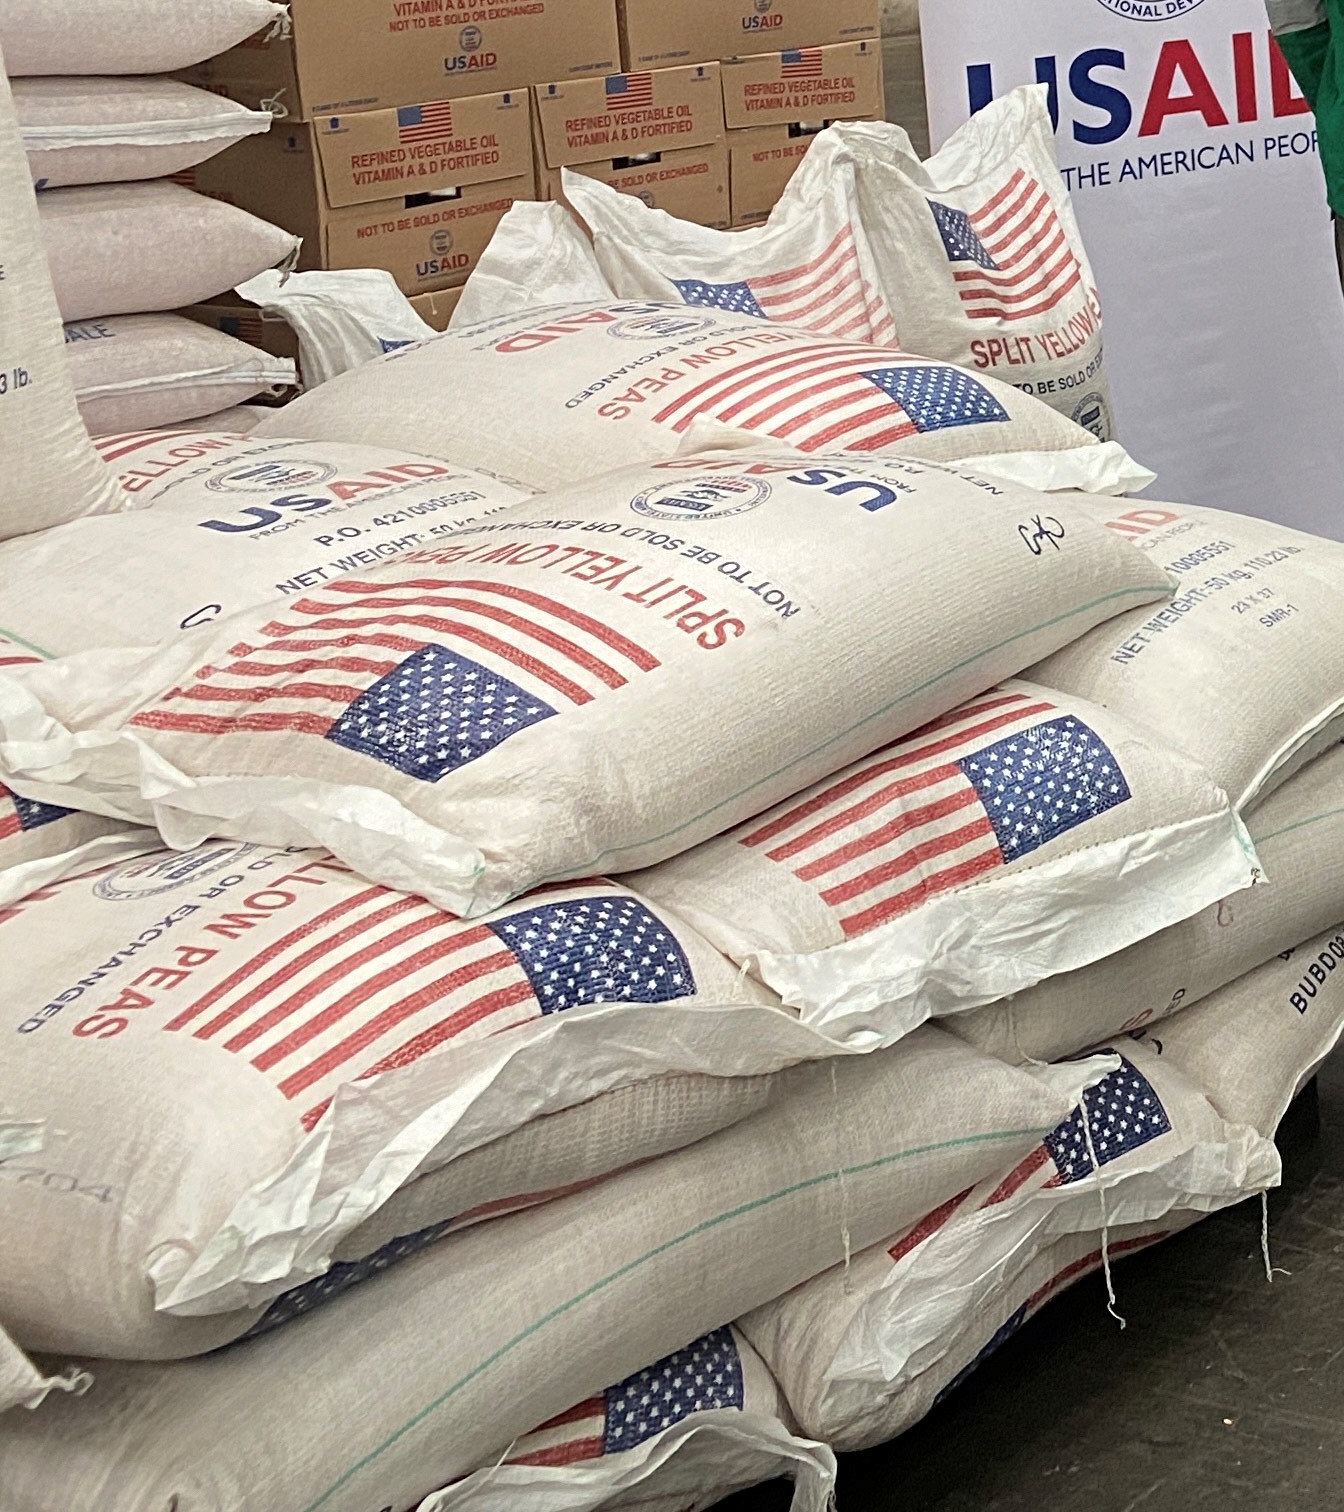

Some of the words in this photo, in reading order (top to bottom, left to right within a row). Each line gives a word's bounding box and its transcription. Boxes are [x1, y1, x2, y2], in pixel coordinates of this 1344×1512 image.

[390, 19, 409, 32] NOT
[411, 17, 426, 29] TO
[429, 15, 441, 27] BE
[444, 12, 470, 25] SOLD
[473, 10, 487, 22] OR
[489, 3, 544, 20] EXCHANGED
[444, 53, 497, 71] USAID
[352, 148, 405, 168] REFINED
[409, 137, 477, 160] VEGETABLE
[480, 134, 498, 149] OIL
[353, 165, 403, 185] VITAMIN
[407, 163, 416, 177] A
[419, 162, 426, 175] &
[430, 160, 437, 173] D
[441, 151, 499, 172] FORTIFIED
[1061, 163, 1111, 192] THE
[1119, 142, 1255, 184] AMERICAN
[357, 224, 377, 238] NOT
[382, 221, 395, 233] TO
[398, 218, 411, 230] BE
[414, 212, 439, 227] SOLD
[443, 209, 456, 222] OR
[416, 254, 469, 276] USAID
[970, 337, 1035, 368] SPLIT
[1034, 306, 1095, 360] YELLOW
[565, 345, 678, 408] EXCHANGED
[598, 367, 687, 420] PEAS
[1037, 380, 1056, 394] BE
[1058, 370, 1085, 390] SOLD
[119, 438, 231, 493] ELLOW
[197, 463, 449, 533] USAID
[313, 525, 371, 547] P.O.
[374, 490, 486, 528] 4210005551
[585, 520, 623, 535] OR
[621, 526, 689, 551] SOLD
[682, 546, 721, 564] BE
[276, 566, 329, 595] NET
[479, 541, 643, 592] YELLOW
[717, 561, 752, 584] TO
[622, 576, 746, 650] SPLIT
[749, 583, 801, 620] NOT
[1259, 604, 1299, 628] SMR-1
[1111, 633, 1151, 665] NET
[1205, 576, 1230, 592] 50
[199, 875, 245, 899] OR
[17, 903, 201, 1034] EXCHANGED
[72, 945, 220, 1040] PEAS
